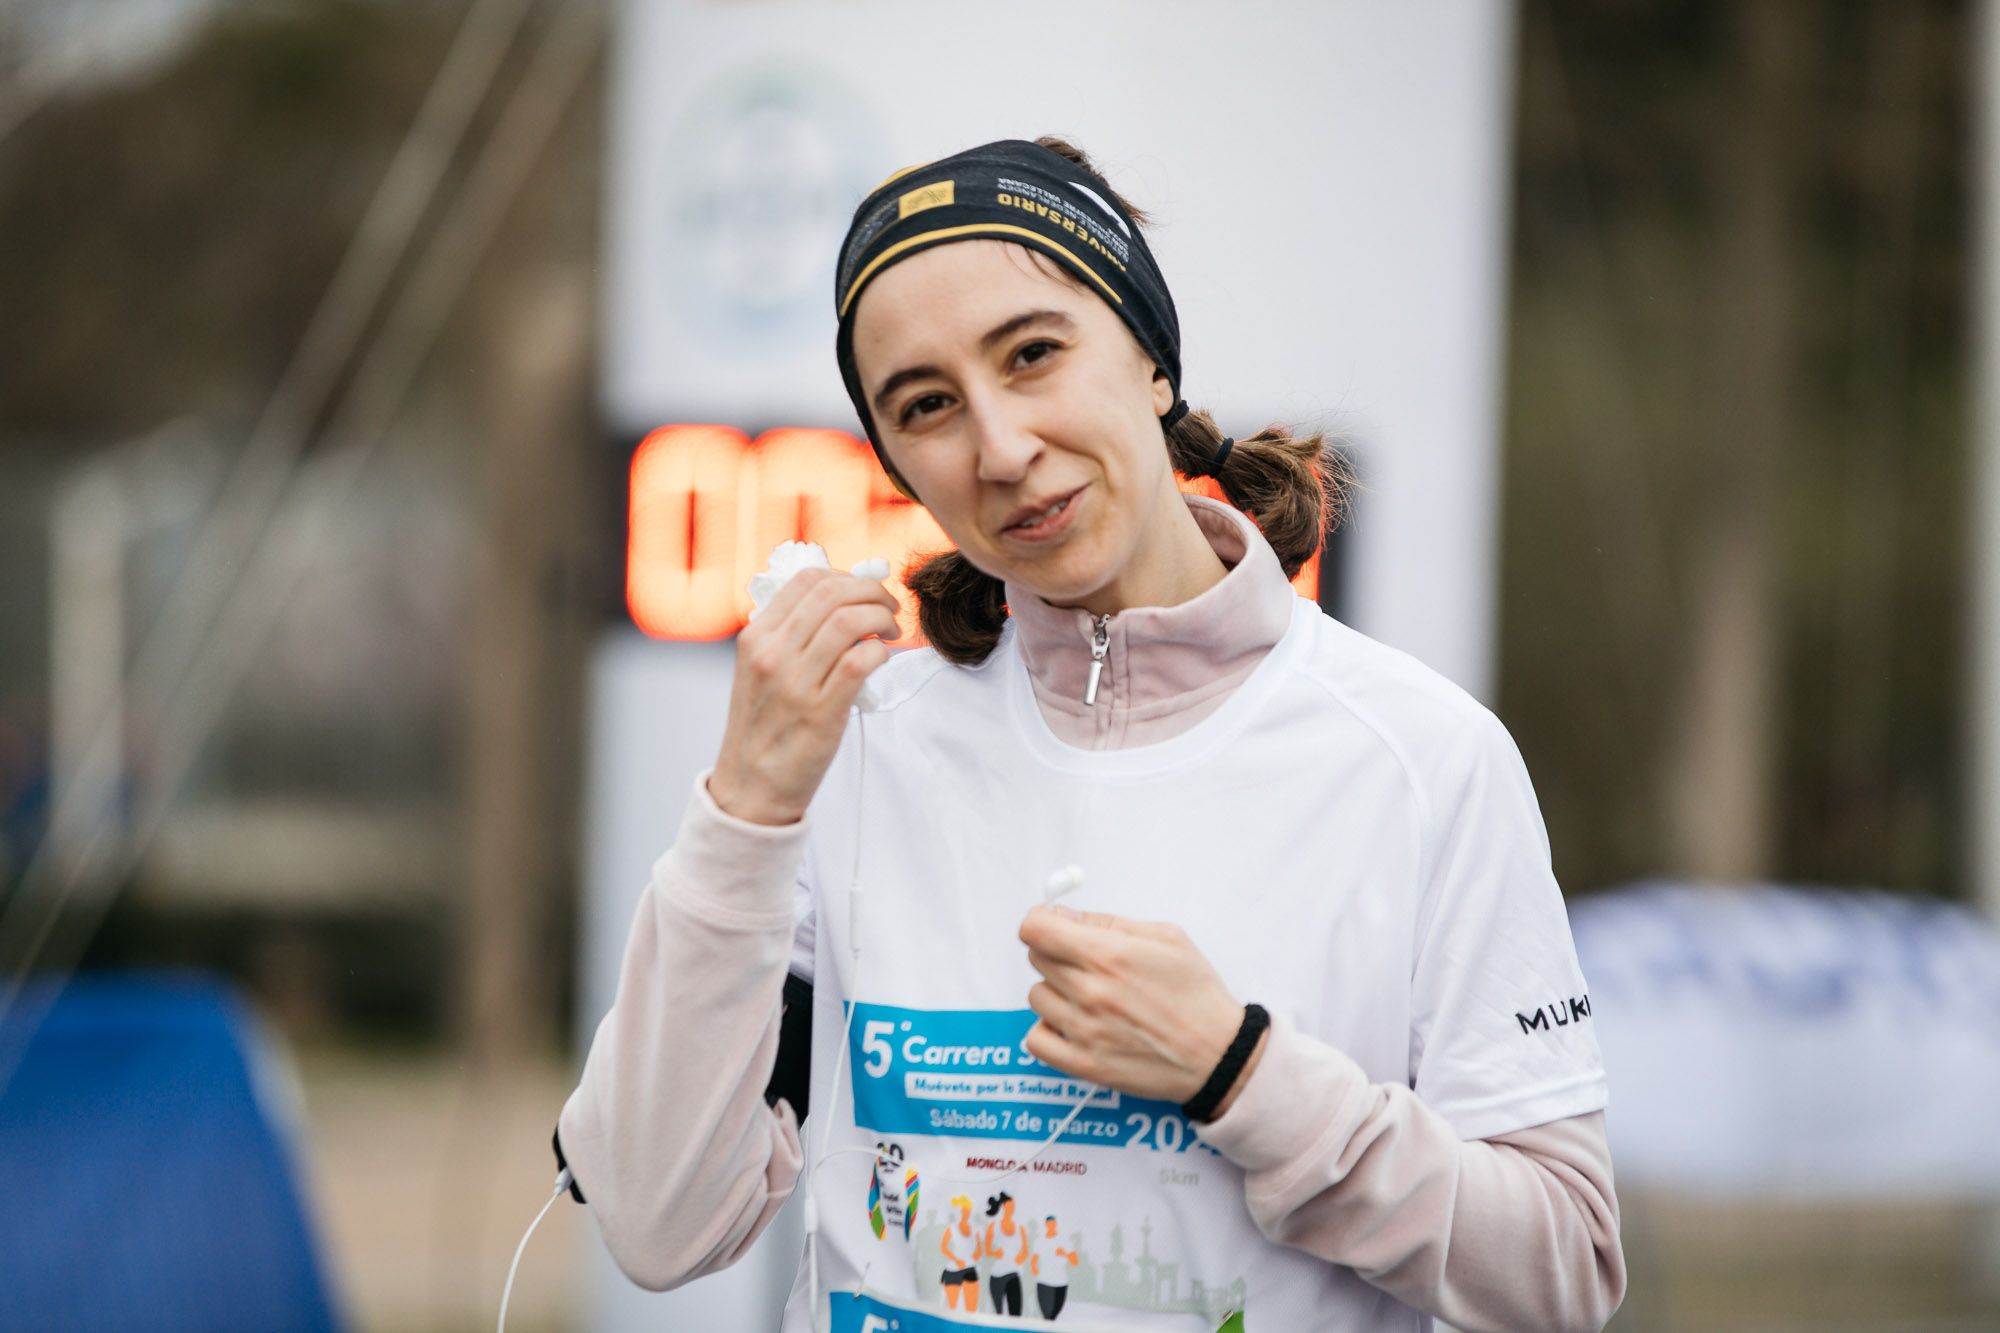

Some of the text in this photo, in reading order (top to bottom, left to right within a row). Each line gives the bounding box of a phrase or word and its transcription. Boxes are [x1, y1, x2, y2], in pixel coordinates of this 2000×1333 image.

[902, 1035, 1011, 1066] Carrera
[976, 1084, 997, 1095] por
[1018, 1081, 1062, 1096] Salud
[929, 1107, 997, 1130] Sábado
[1001, 1110, 1012, 1130] 7
[1015, 1110, 1042, 1132] de
[1048, 1117, 1119, 1137] marzo
[1033, 1160, 1088, 1176] MADRID
[1159, 1168, 1199, 1186] 5km
